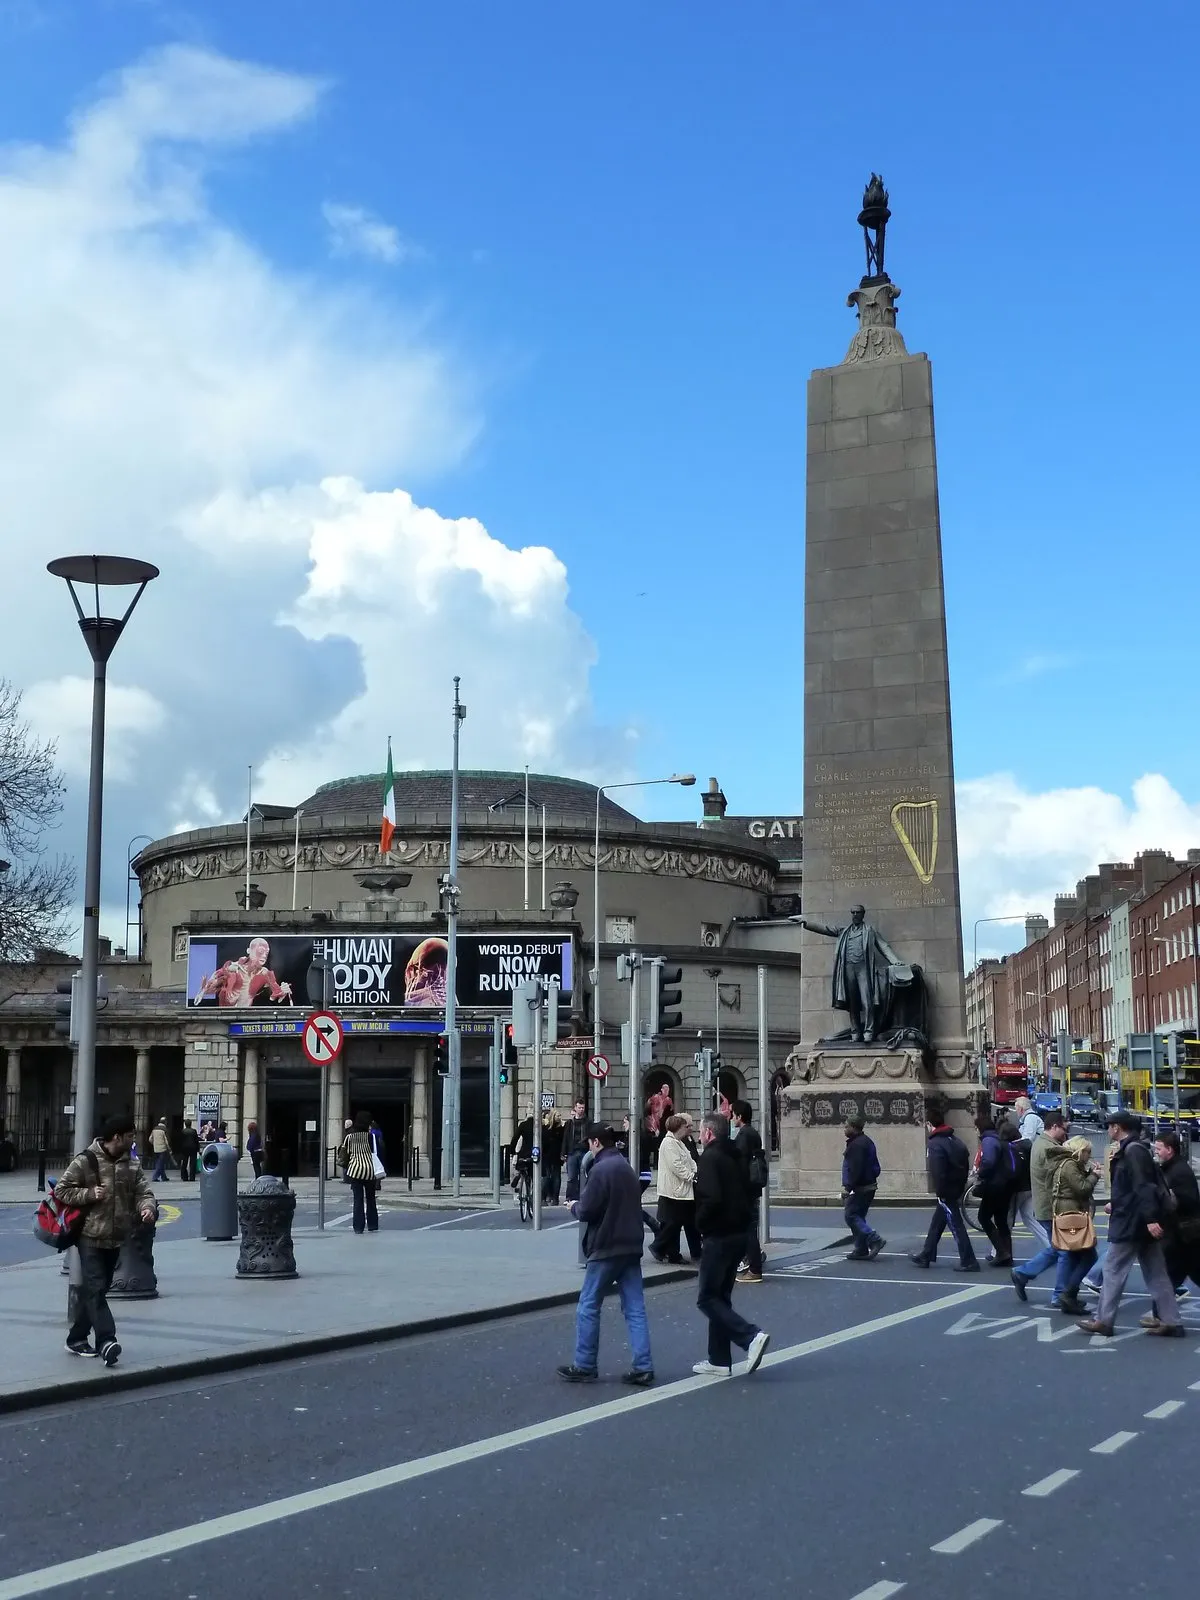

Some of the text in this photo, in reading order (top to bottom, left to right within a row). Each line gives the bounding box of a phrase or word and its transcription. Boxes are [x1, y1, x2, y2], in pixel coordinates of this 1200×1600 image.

[815, 763, 826, 771] TO
[313, 940, 323, 961] THE
[324, 939, 392, 963] HUMAN
[479, 944, 563, 955] WORLD DEBUT
[499, 956, 541, 973] NOW
[332, 964, 392, 990] ODY
[333, 990, 390, 1004] HIBITION
[242, 1024, 261, 1033] TICKETS
[285, 1023, 296, 1032] 300
[460, 1024, 472, 1032] ETS
